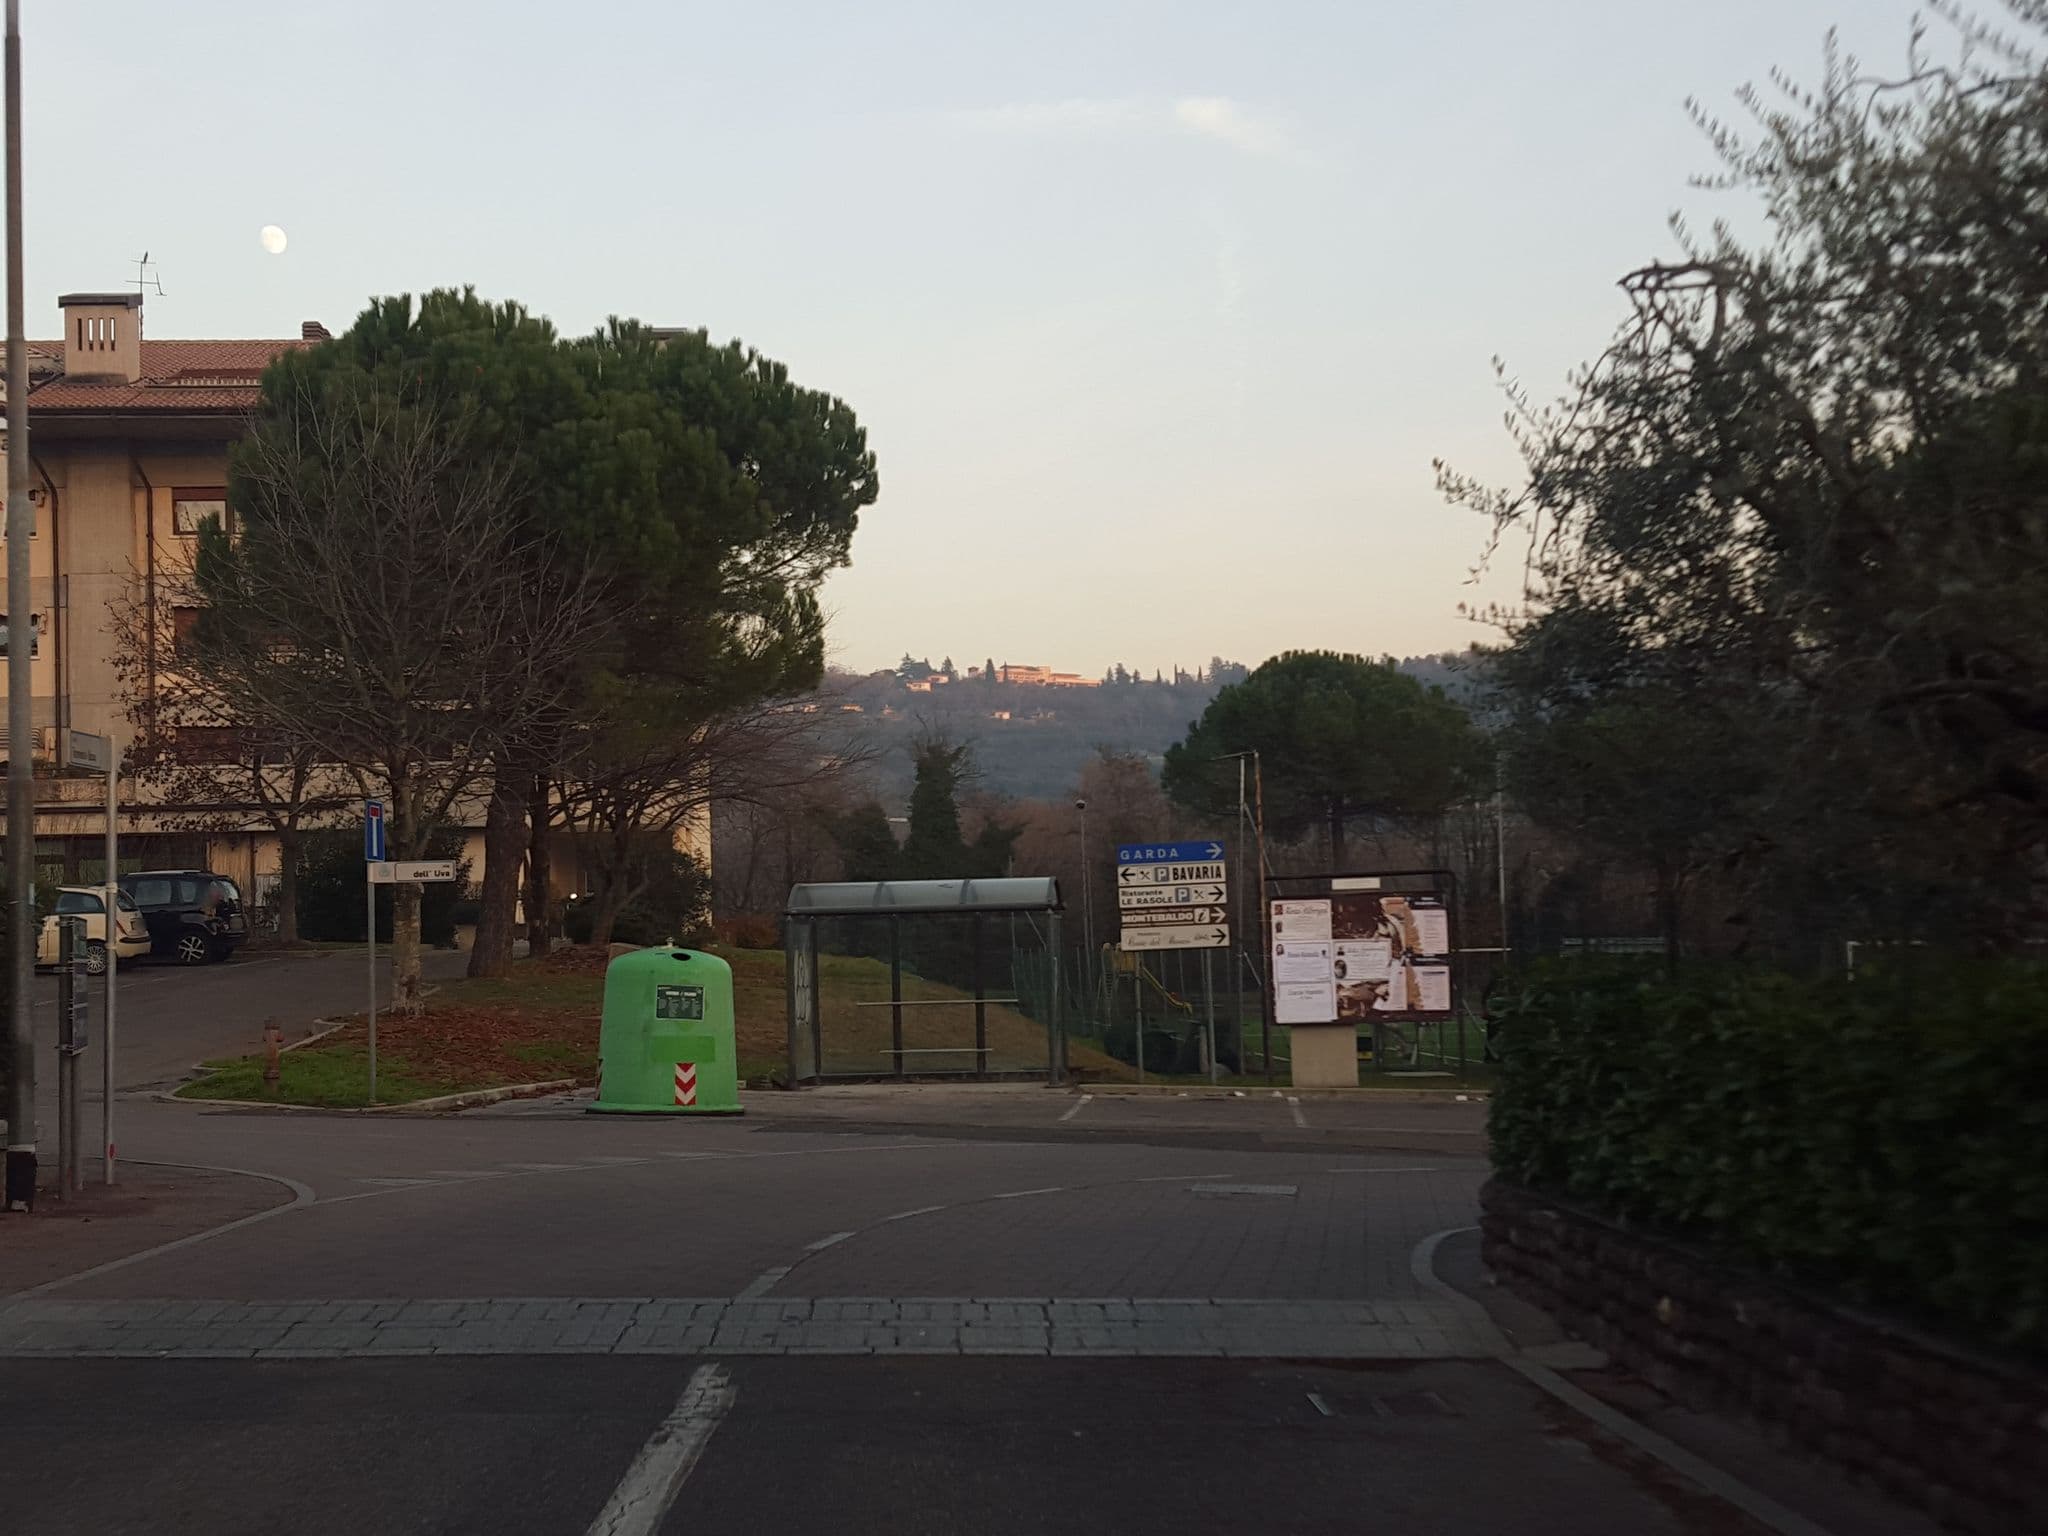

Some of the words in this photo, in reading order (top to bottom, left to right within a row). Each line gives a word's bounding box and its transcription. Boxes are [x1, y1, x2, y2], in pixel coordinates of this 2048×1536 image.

[1120, 848, 1179, 860] GARDA
[1172, 865, 1222, 881] BAVARIA
[1121, 889, 1163, 897] Ristorante
[1121, 897, 1133, 905] LE
[1136, 896, 1173, 905] RASOLE
[1121, 912, 1194, 923] MONTEBALDO
